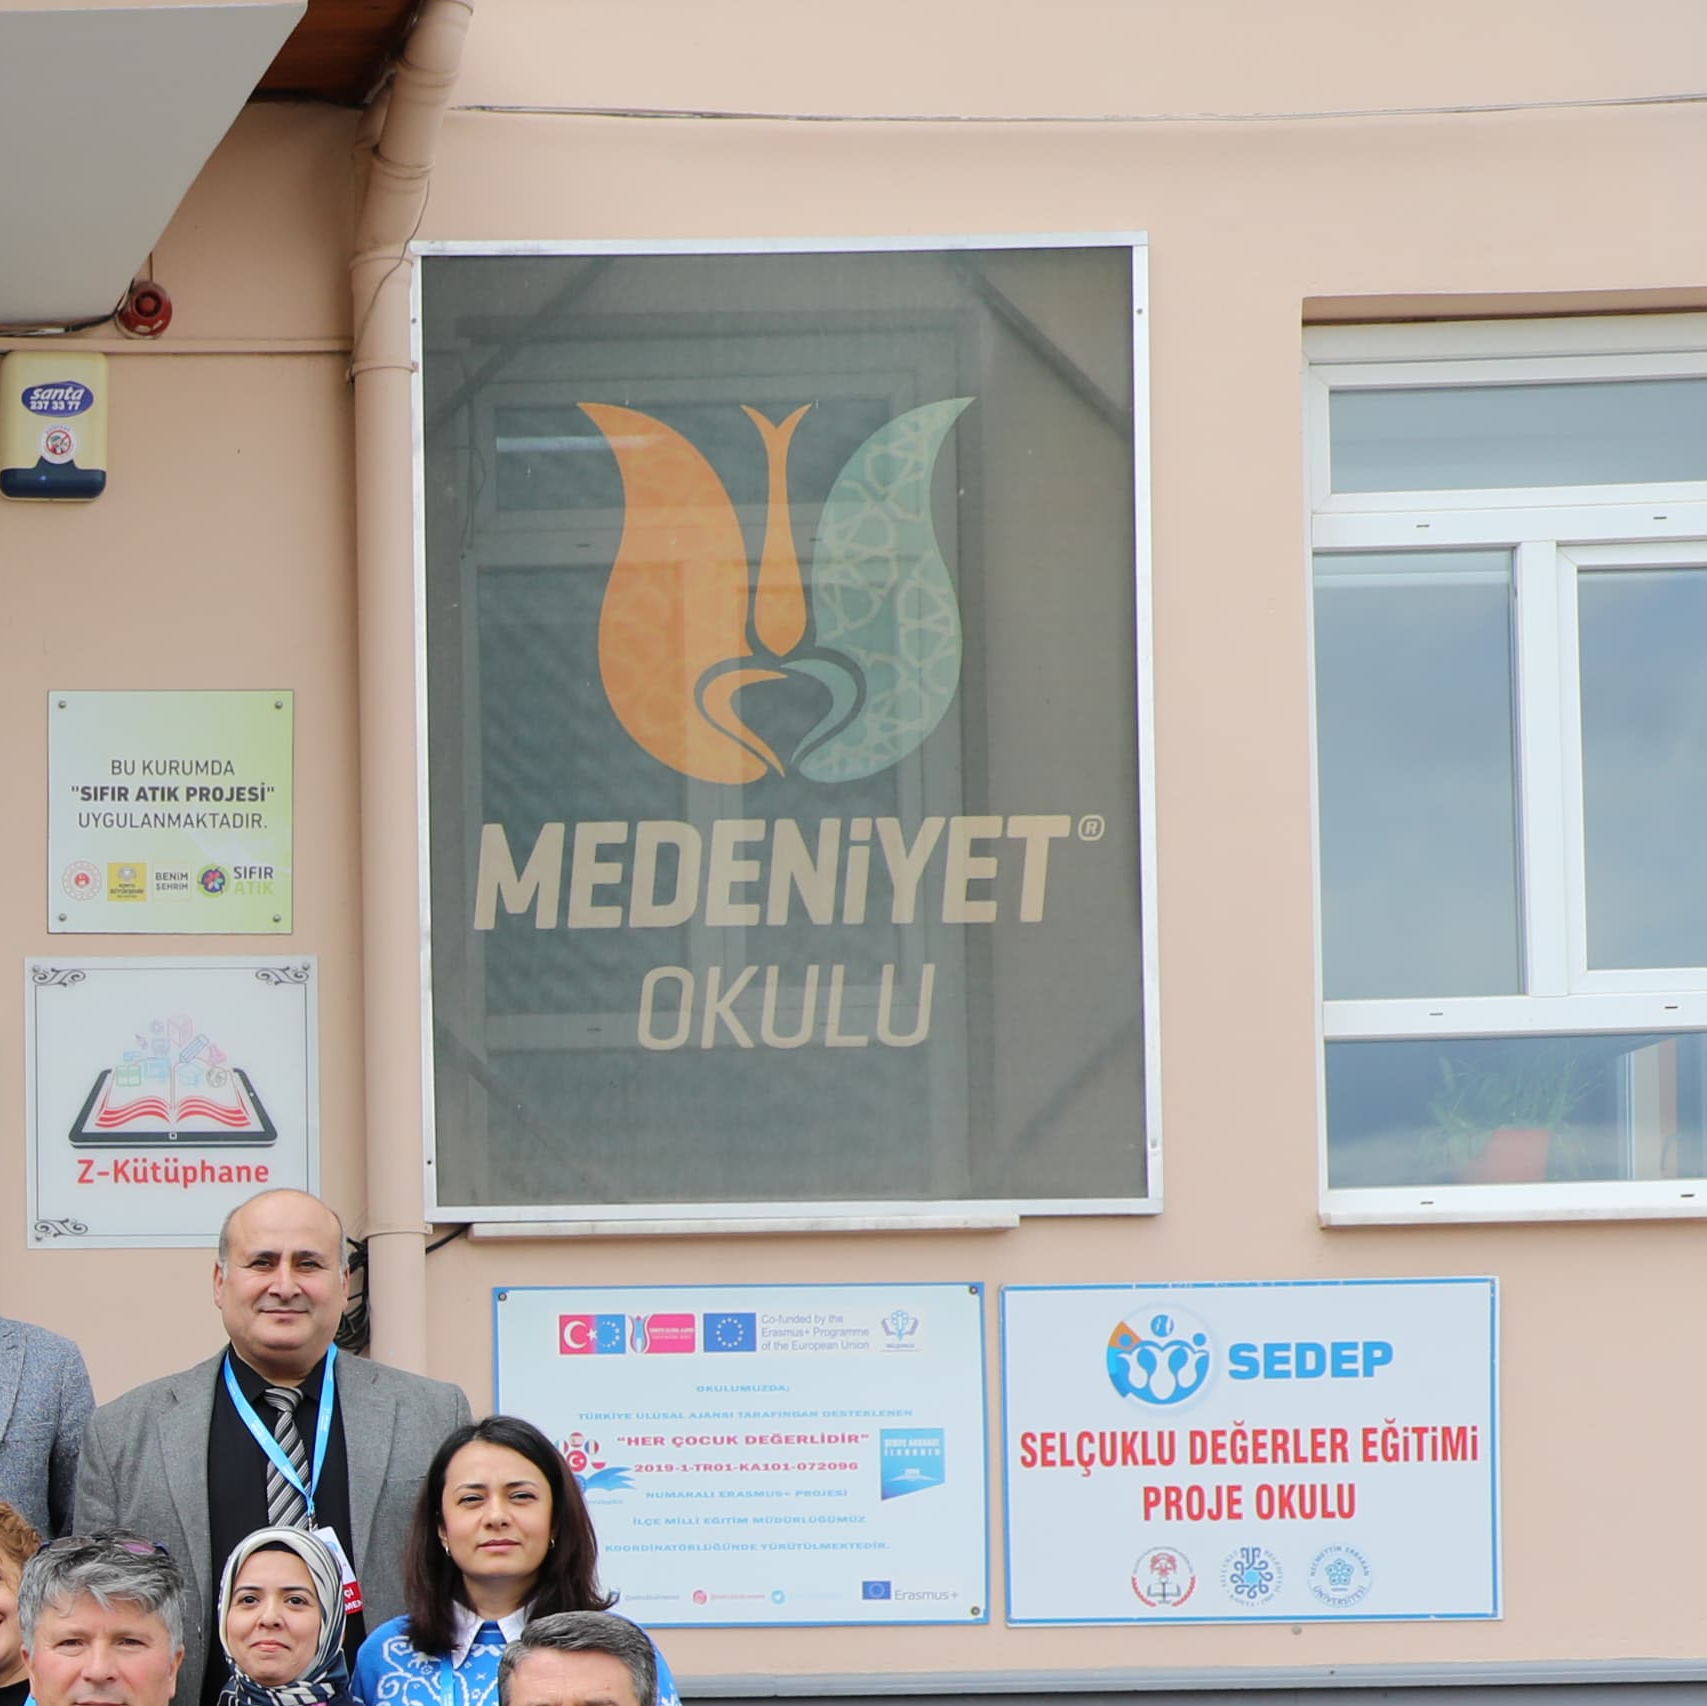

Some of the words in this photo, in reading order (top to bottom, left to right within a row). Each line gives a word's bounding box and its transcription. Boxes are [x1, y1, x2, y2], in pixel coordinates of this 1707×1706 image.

[30, 386, 85, 401] santa
[30, 401, 49, 410] 237
[51, 401, 66, 410] 33
[68, 401, 81, 410] 77
[110, 759, 136, 776] BU
[142, 759, 235, 776] KURUMDA
[71, 786, 130, 802] "SIFIR
[135, 786, 179, 802] ATIK
[186, 782, 275, 802] PROJESİ"
[78, 812, 268, 829] UYGULANMAKTADIR.
[234, 866, 274, 880] SIFIR
[234, 881, 274, 895] ATIK
[636, 963, 936, 1051] OKULU
[76, 1157, 270, 1189] Z-Kütüphane
[761, 1314, 812, 1325] Co-funded
[814, 1314, 826, 1326] by
[828, 1314, 844, 1324] the
[761, 1327, 809, 1338] Erasmus+
[813, 1327, 869, 1340] Programme
[761, 1340, 772, 1351] of
[773, 1340, 789, 1350] the
[791, 1340, 838, 1352] European
[840, 1340, 869, 1350] Union
[1228, 1341, 1394, 1381] SEDEP
[635, 1411, 685, 1420] ULUSAL
[822, 1409, 913, 1418] DESTEKLENEN
[671, 1435, 739, 1448] ÇOCUK
[1020, 1430, 1176, 1478] SELÇUKLU
[1189, 1419, 1350, 1465] DEĞERLER
[634, 1461, 859, 1473] 2019-1-TR01-KA101-072096
[1142, 1484, 1244, 1522] PROJE
[1255, 1483, 1357, 1520] OKULU
[894, 1589, 959, 1601] Erasmus+
